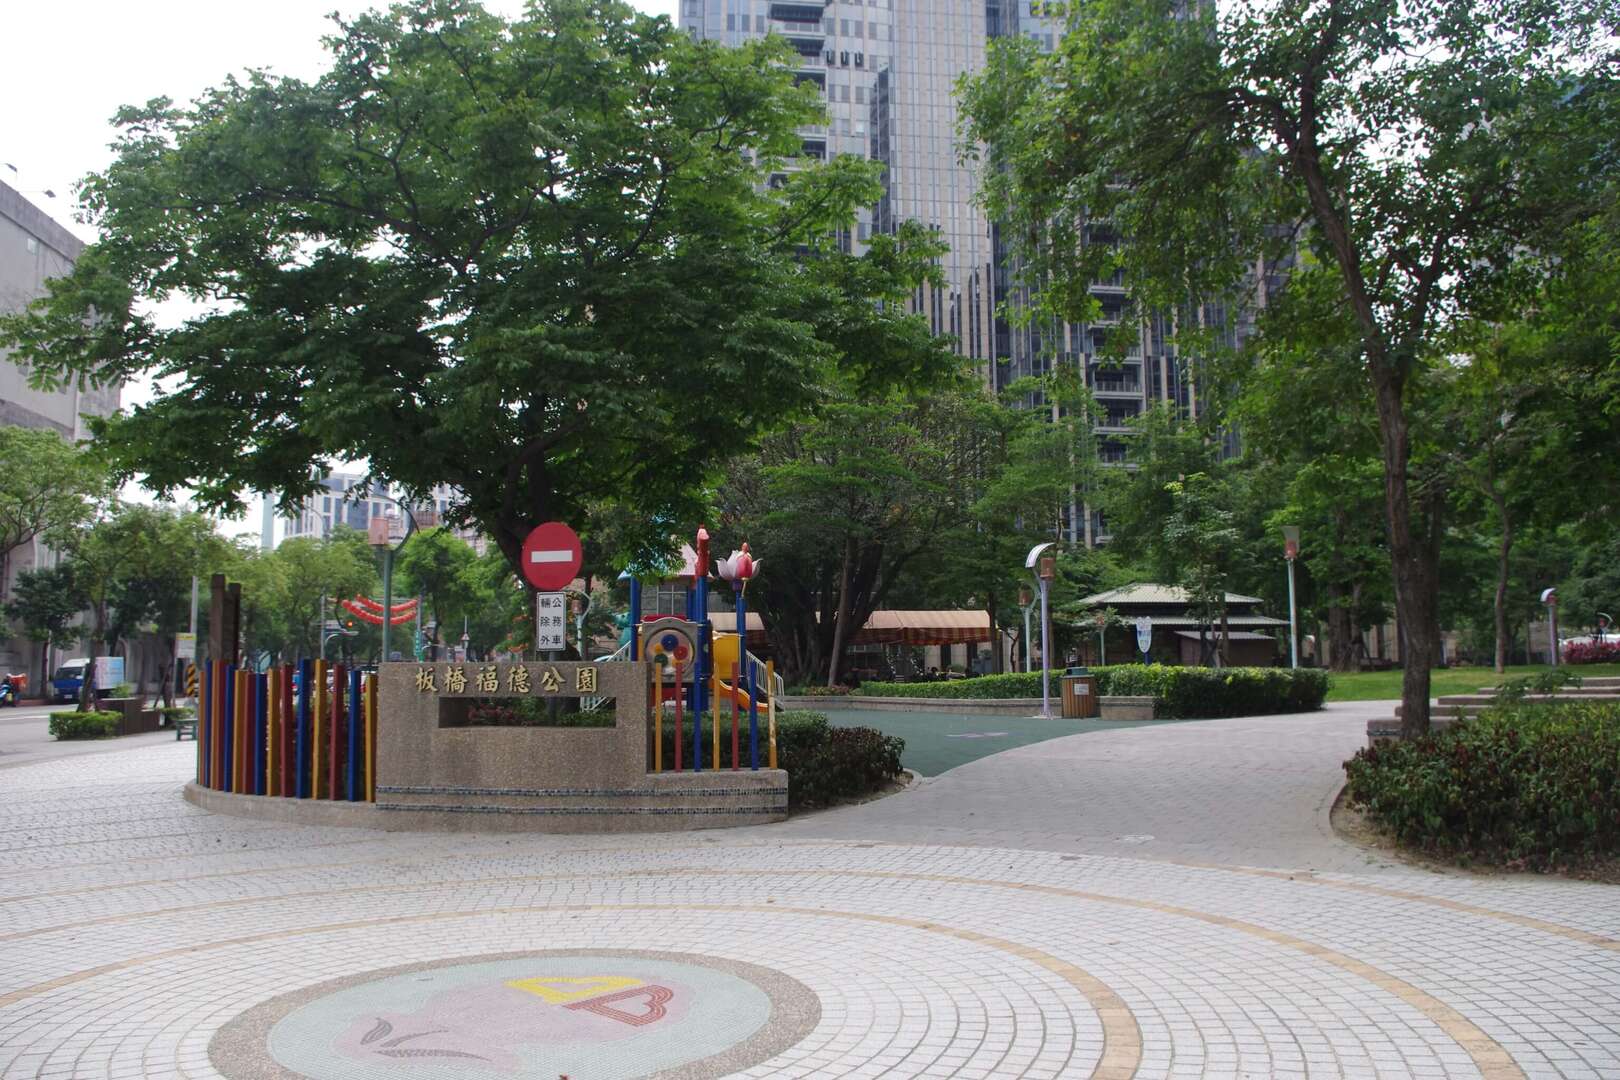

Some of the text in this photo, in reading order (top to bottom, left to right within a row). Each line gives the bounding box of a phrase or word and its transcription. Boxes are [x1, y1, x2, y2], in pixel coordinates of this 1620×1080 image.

[552, 597, 562, 645] 公務車
[415, 664, 598, 694] 板橋福德公園
